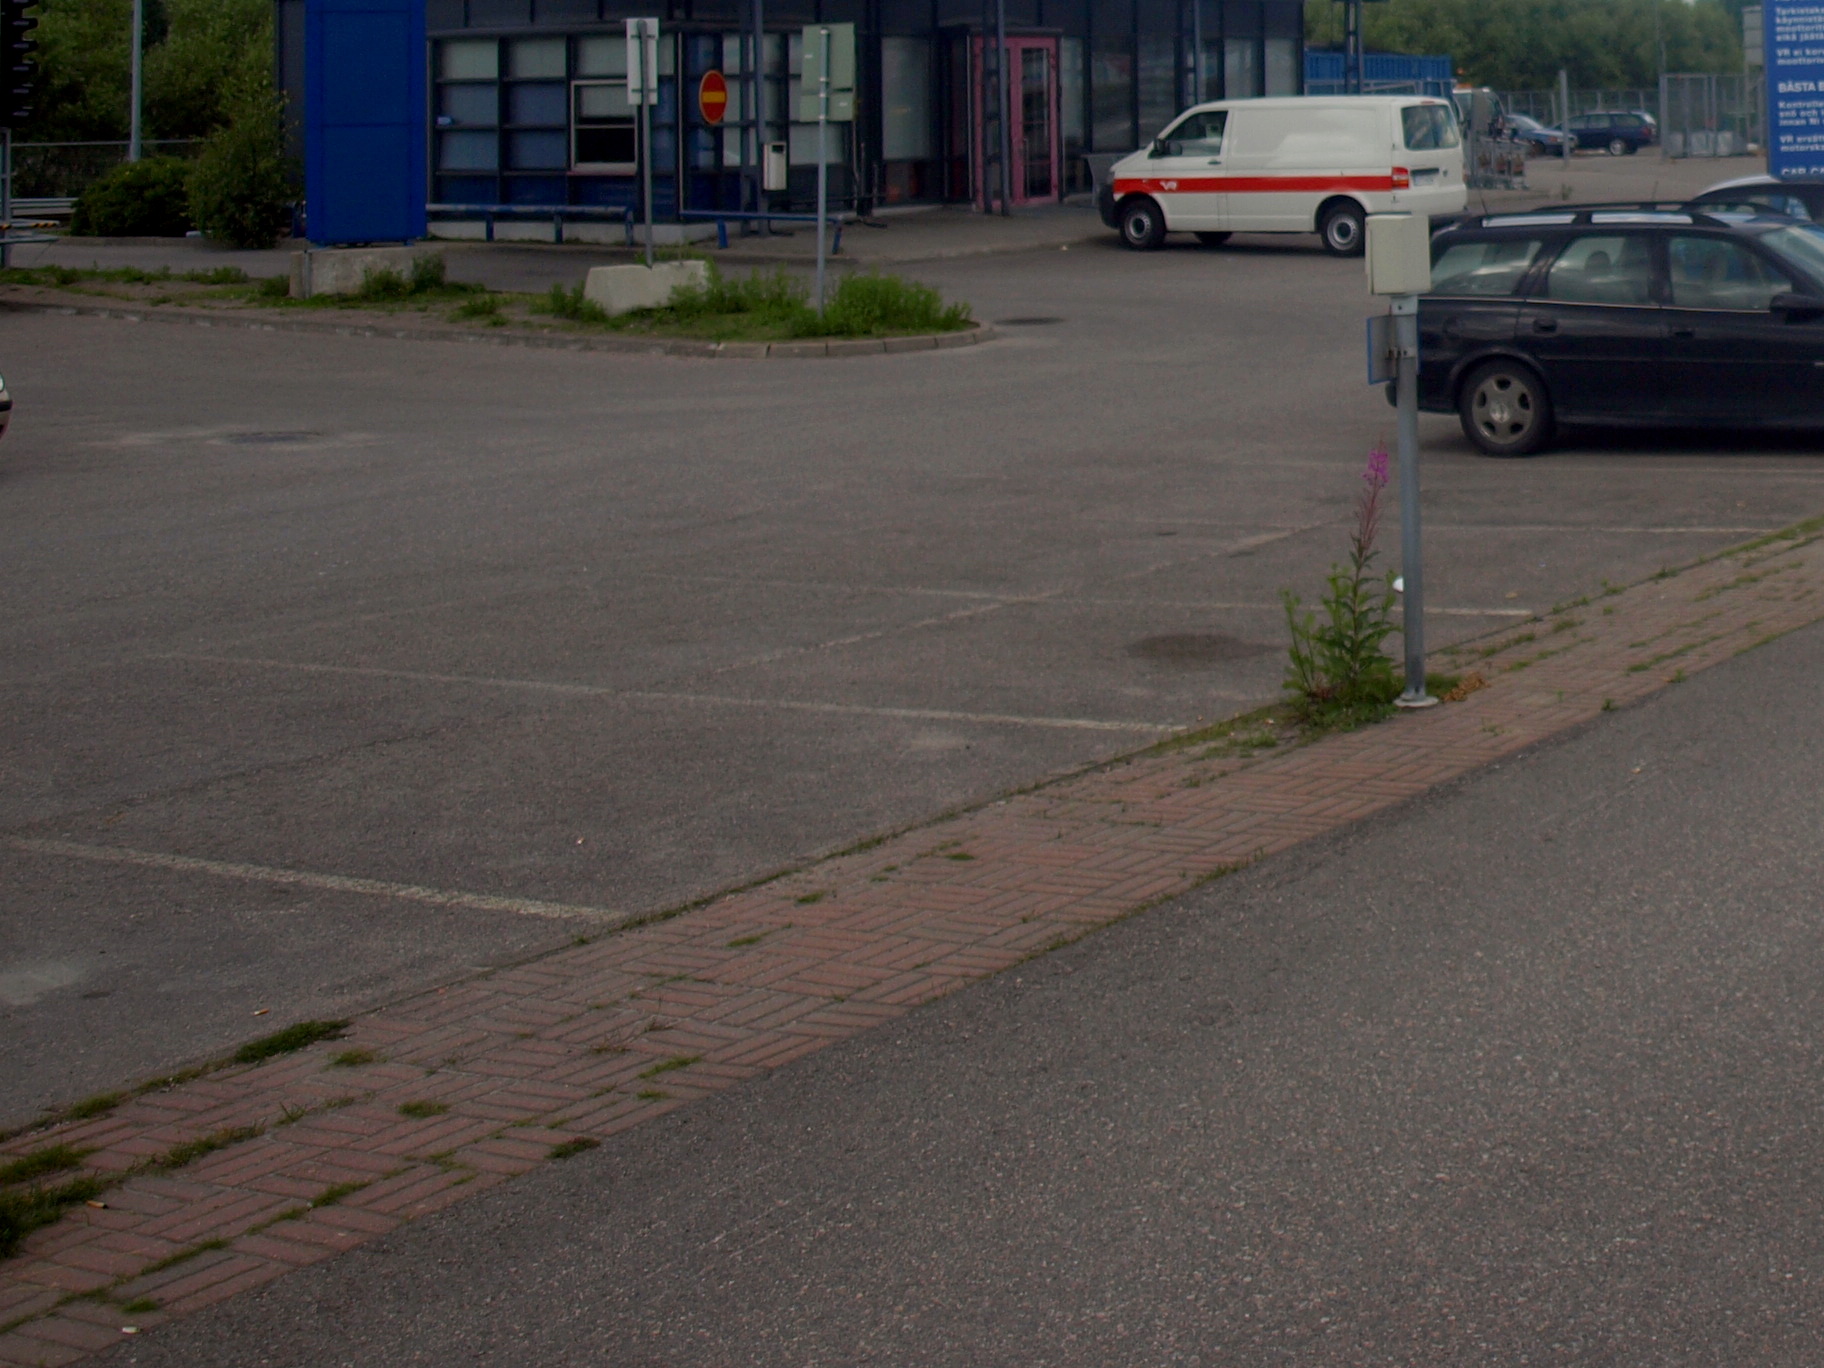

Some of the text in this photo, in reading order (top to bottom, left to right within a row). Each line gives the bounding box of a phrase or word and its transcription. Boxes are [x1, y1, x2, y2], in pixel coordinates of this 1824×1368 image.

[1777, 48, 1791, 57] VR
[1778, 80, 1816, 93] BÄSTA
[1780, 134, 1794, 144] VR
